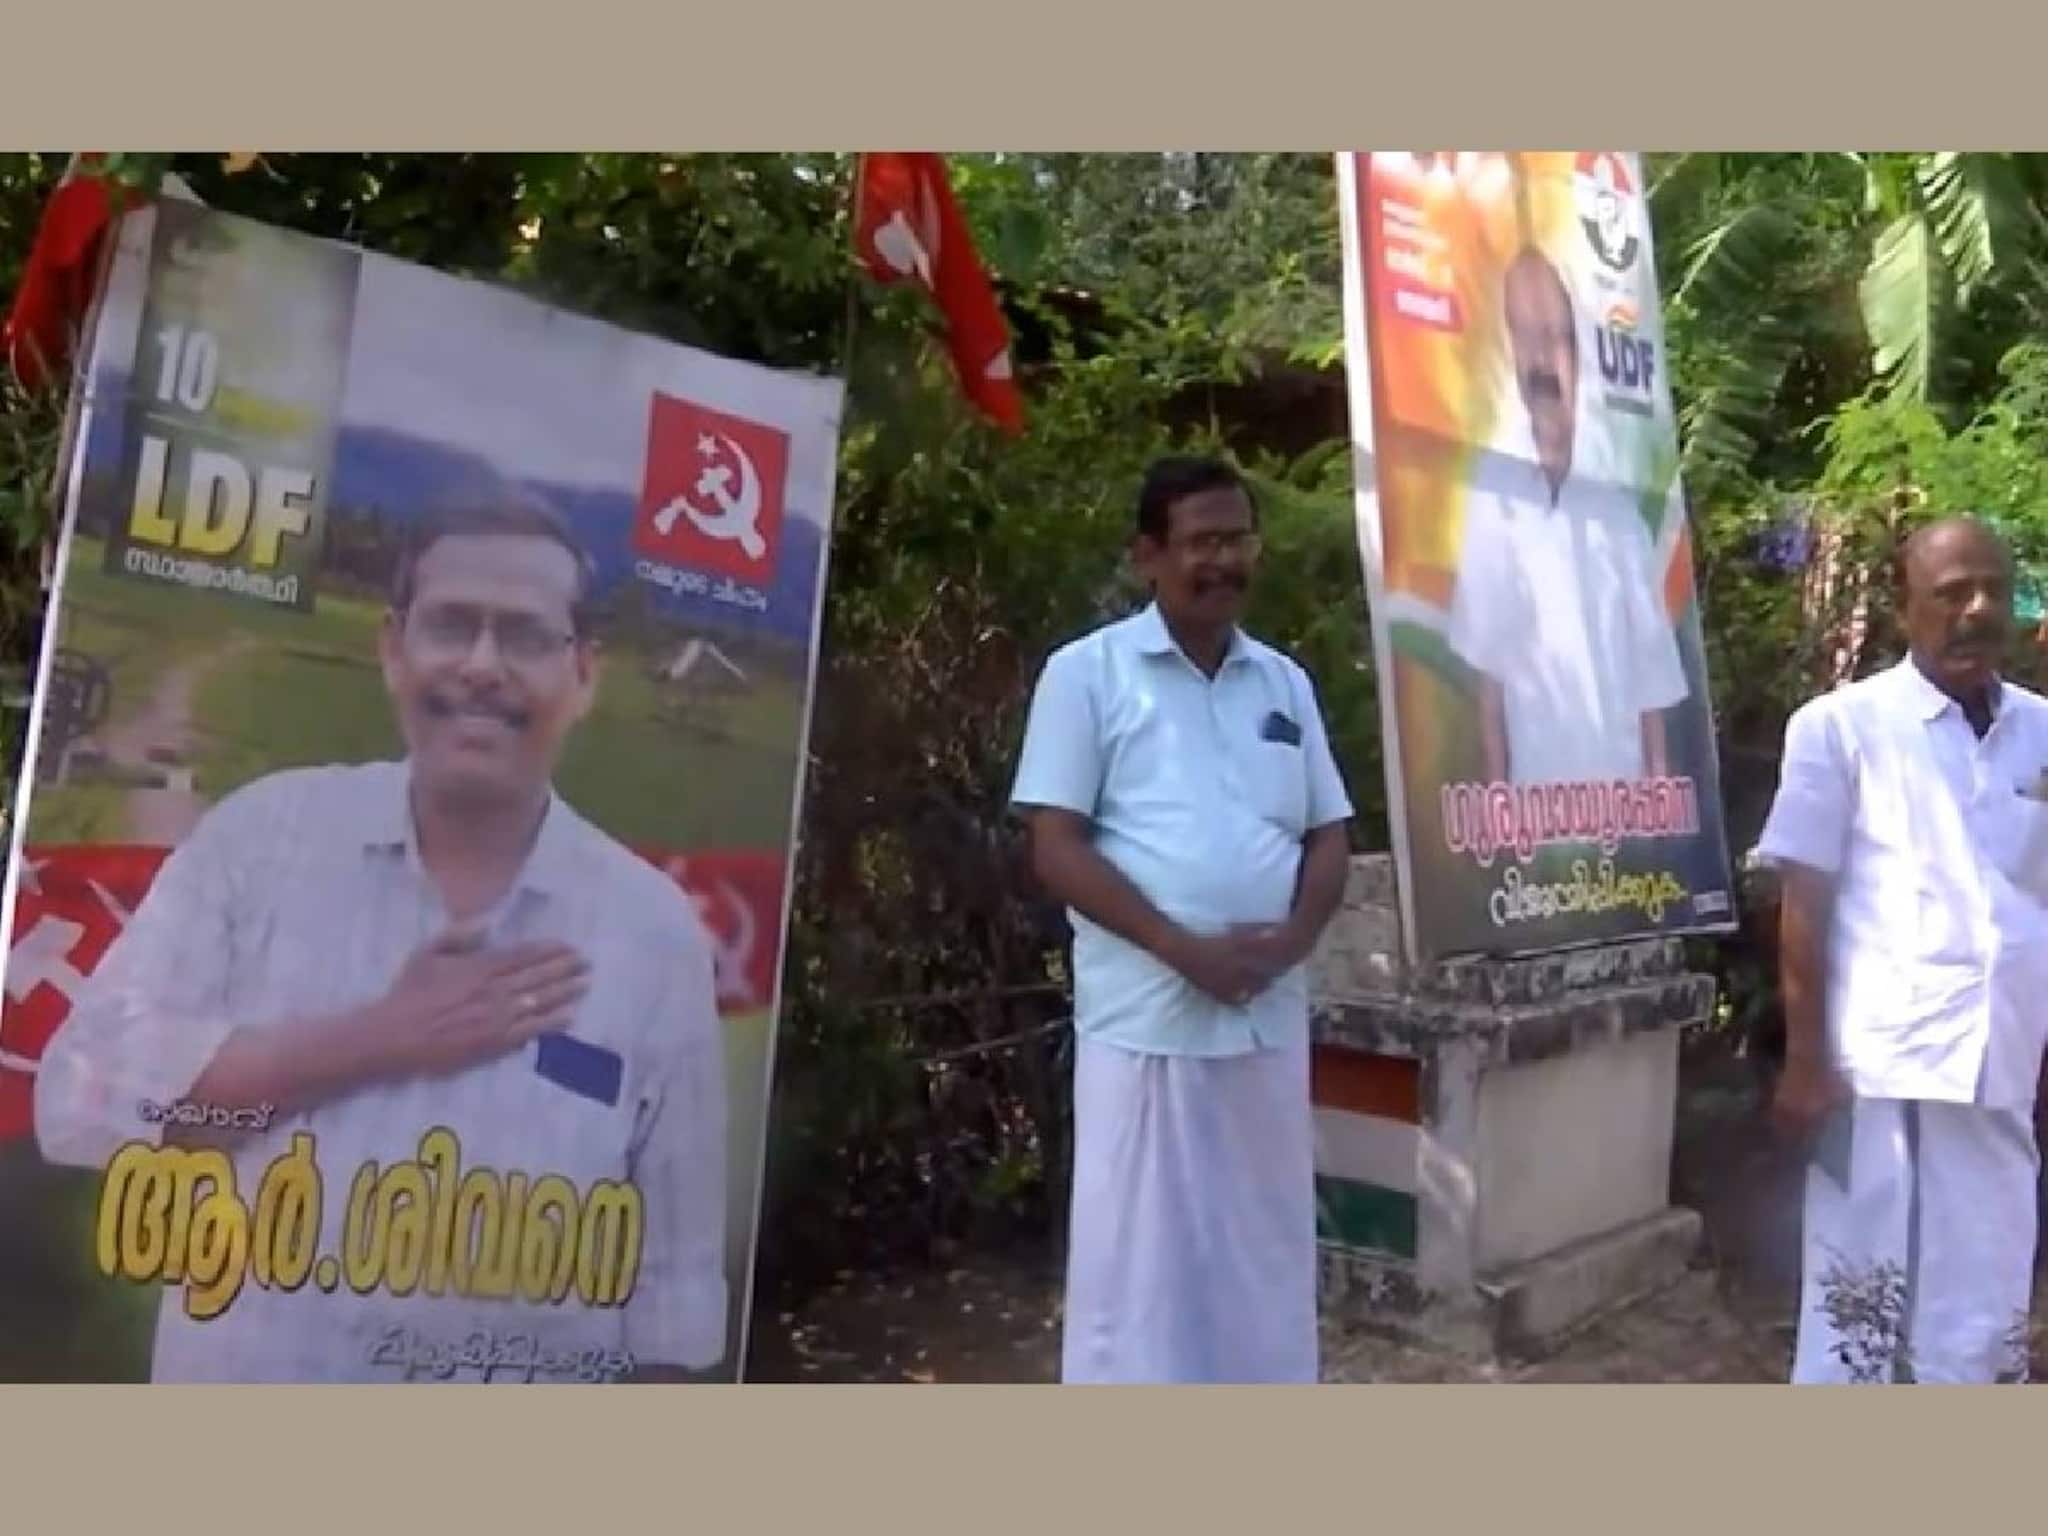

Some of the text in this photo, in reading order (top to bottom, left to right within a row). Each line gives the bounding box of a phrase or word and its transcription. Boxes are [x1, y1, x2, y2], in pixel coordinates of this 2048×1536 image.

[156, 325, 218, 411] 10
[1595, 325, 1655, 394] UDF
[128, 435, 318, 570] LDF
